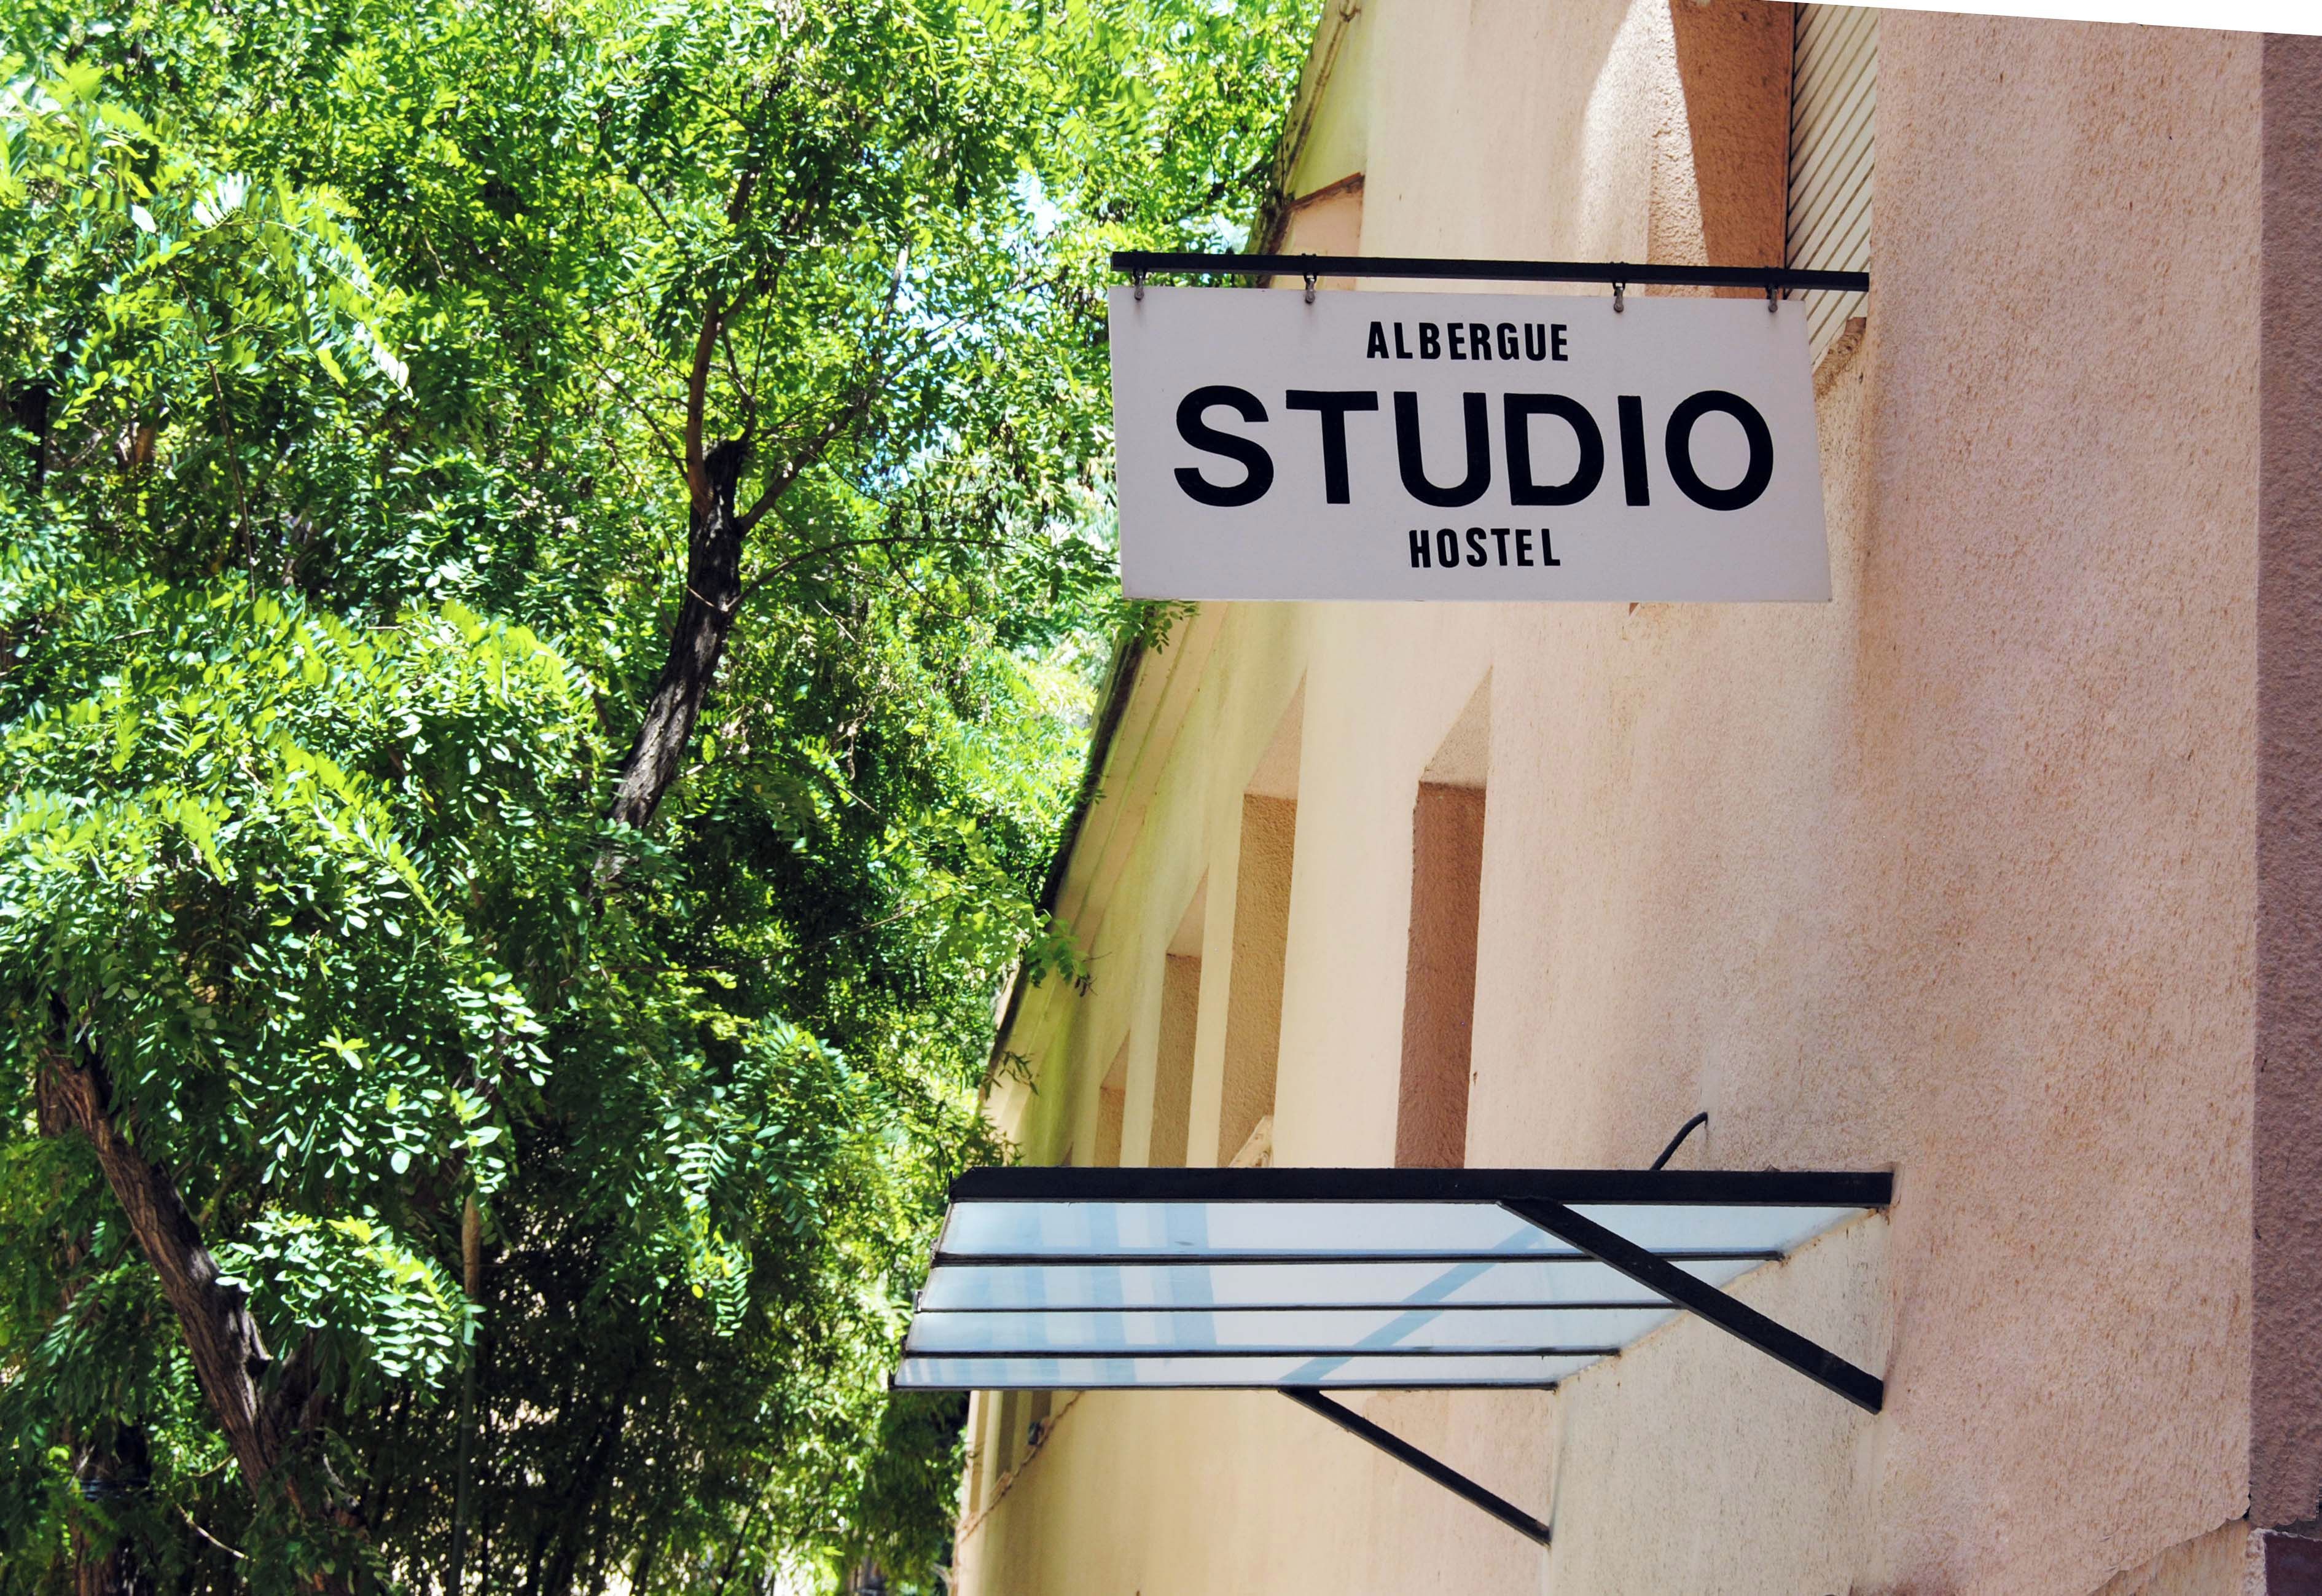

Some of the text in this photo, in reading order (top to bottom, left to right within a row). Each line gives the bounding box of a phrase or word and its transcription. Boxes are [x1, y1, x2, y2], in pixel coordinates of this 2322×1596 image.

[1366, 321, 1569, 362] ALBERGUE
[1174, 385, 1774, 511] STUDIO
[1409, 527, 1562, 568] HOSTEL
